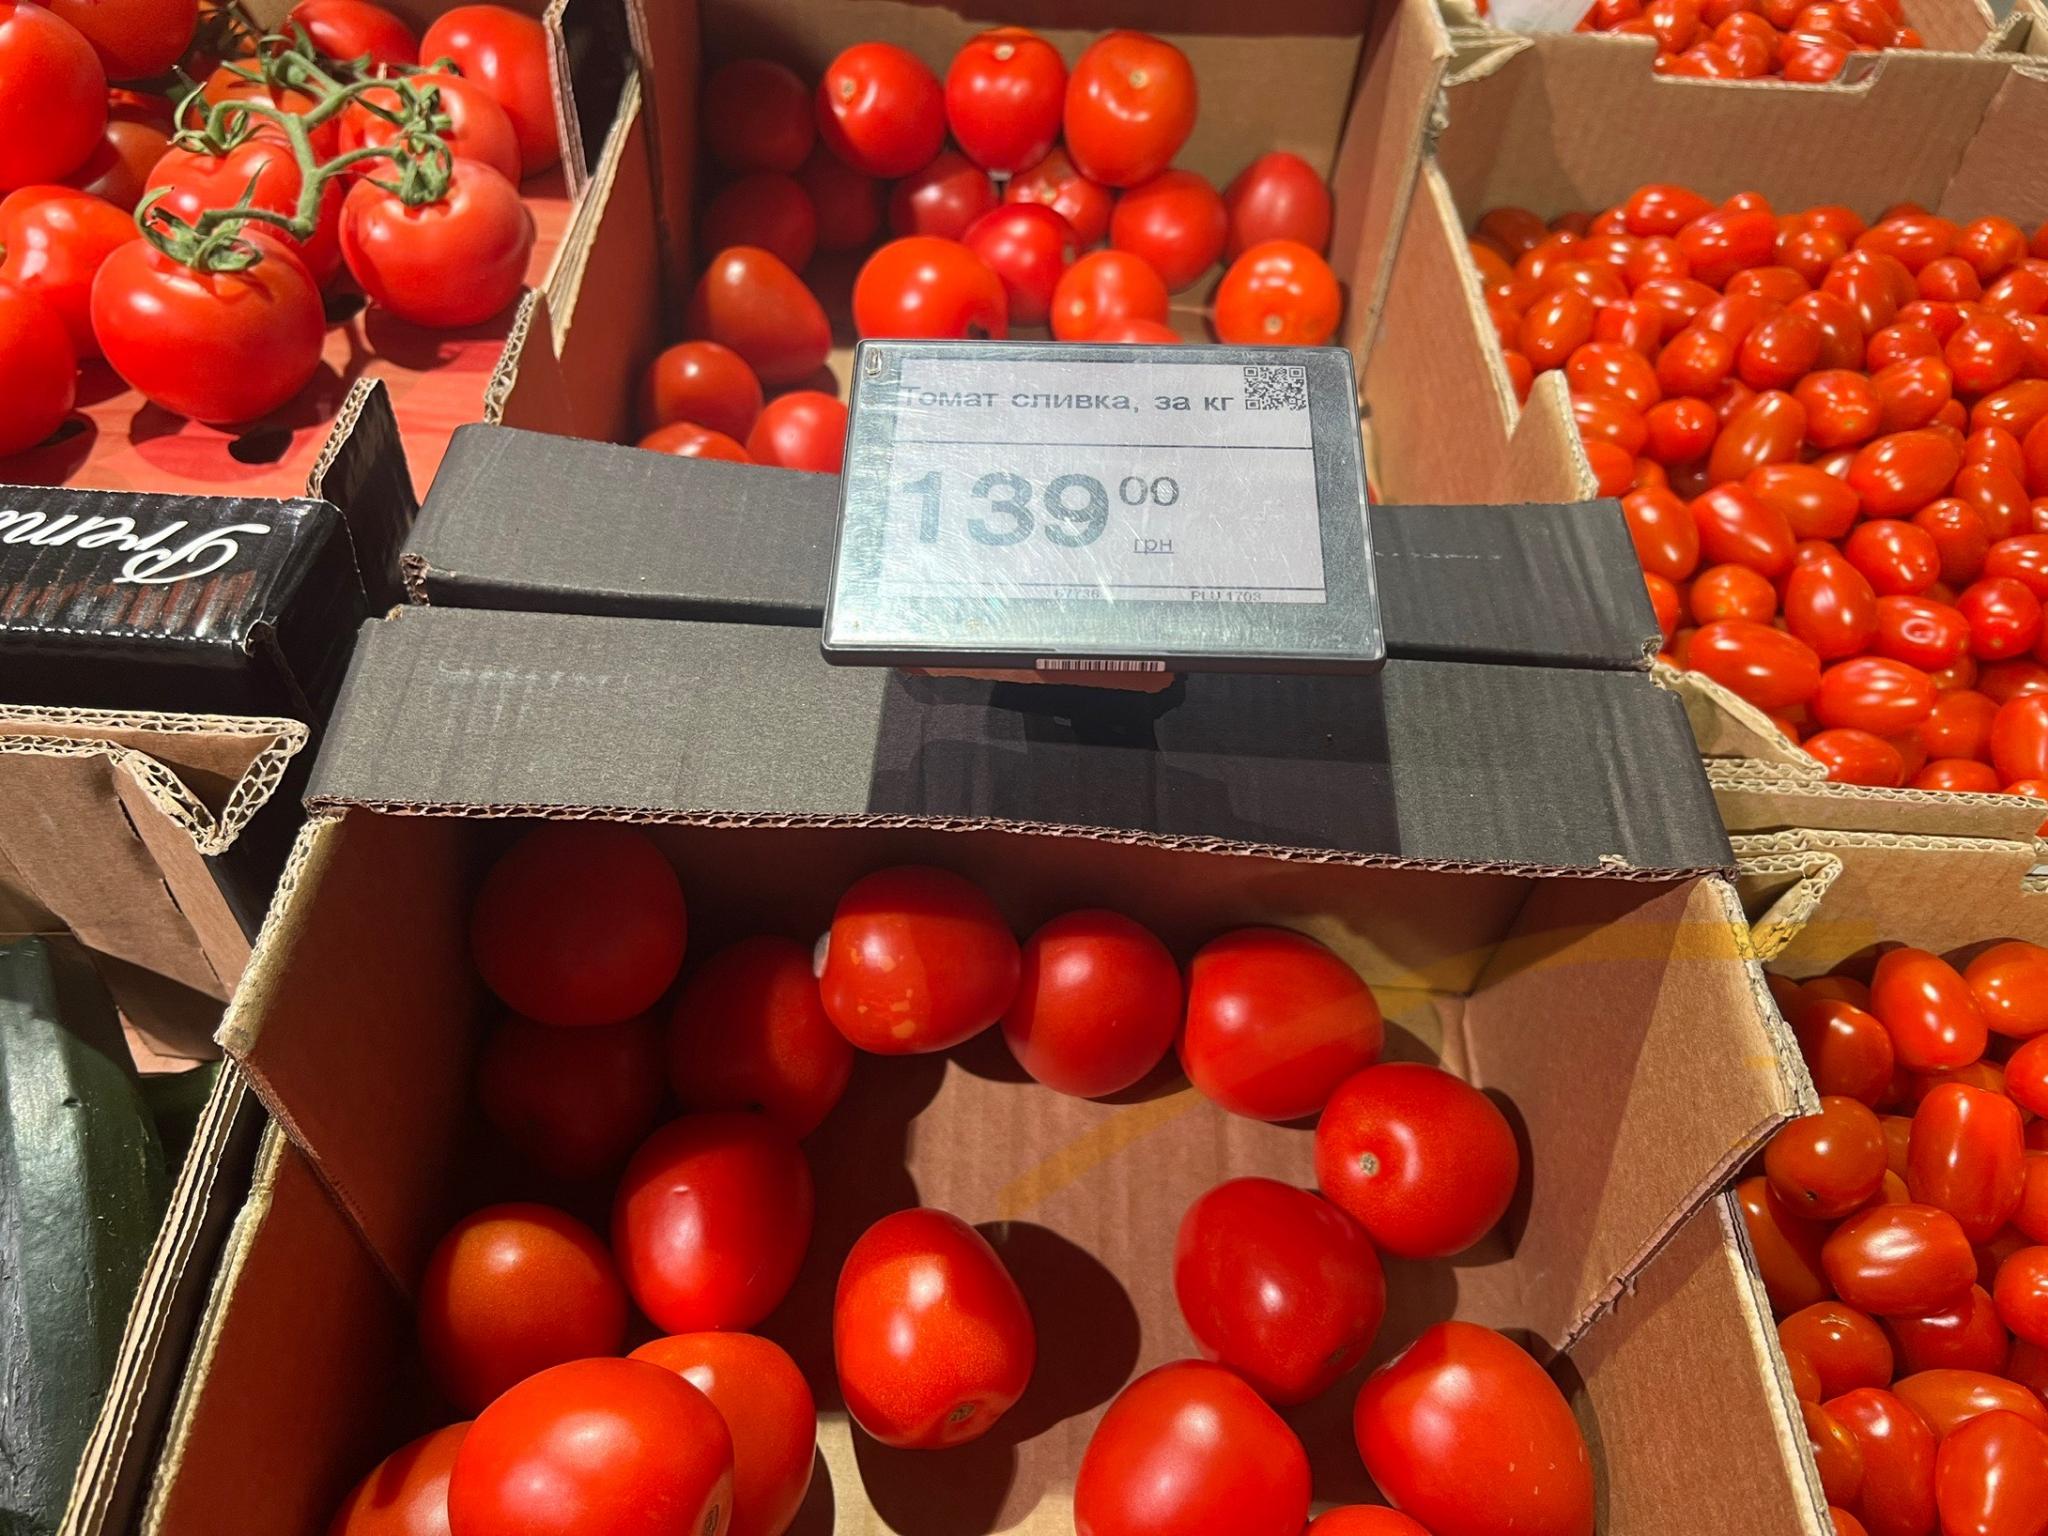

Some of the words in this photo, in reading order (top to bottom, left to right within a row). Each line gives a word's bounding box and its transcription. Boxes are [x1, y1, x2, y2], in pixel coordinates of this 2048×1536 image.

[900, 385, 999, 408] Томат
[1011, 391, 1139, 414] сливка,
[1154, 394, 1191, 411] за
[1204, 396, 1235, 412] кг
[902, 470, 1110, 549] 139
[1118, 475, 1180, 507] 00
[1134, 538, 1174, 555] грн
[1191, 590, 1221, 601] PLU
